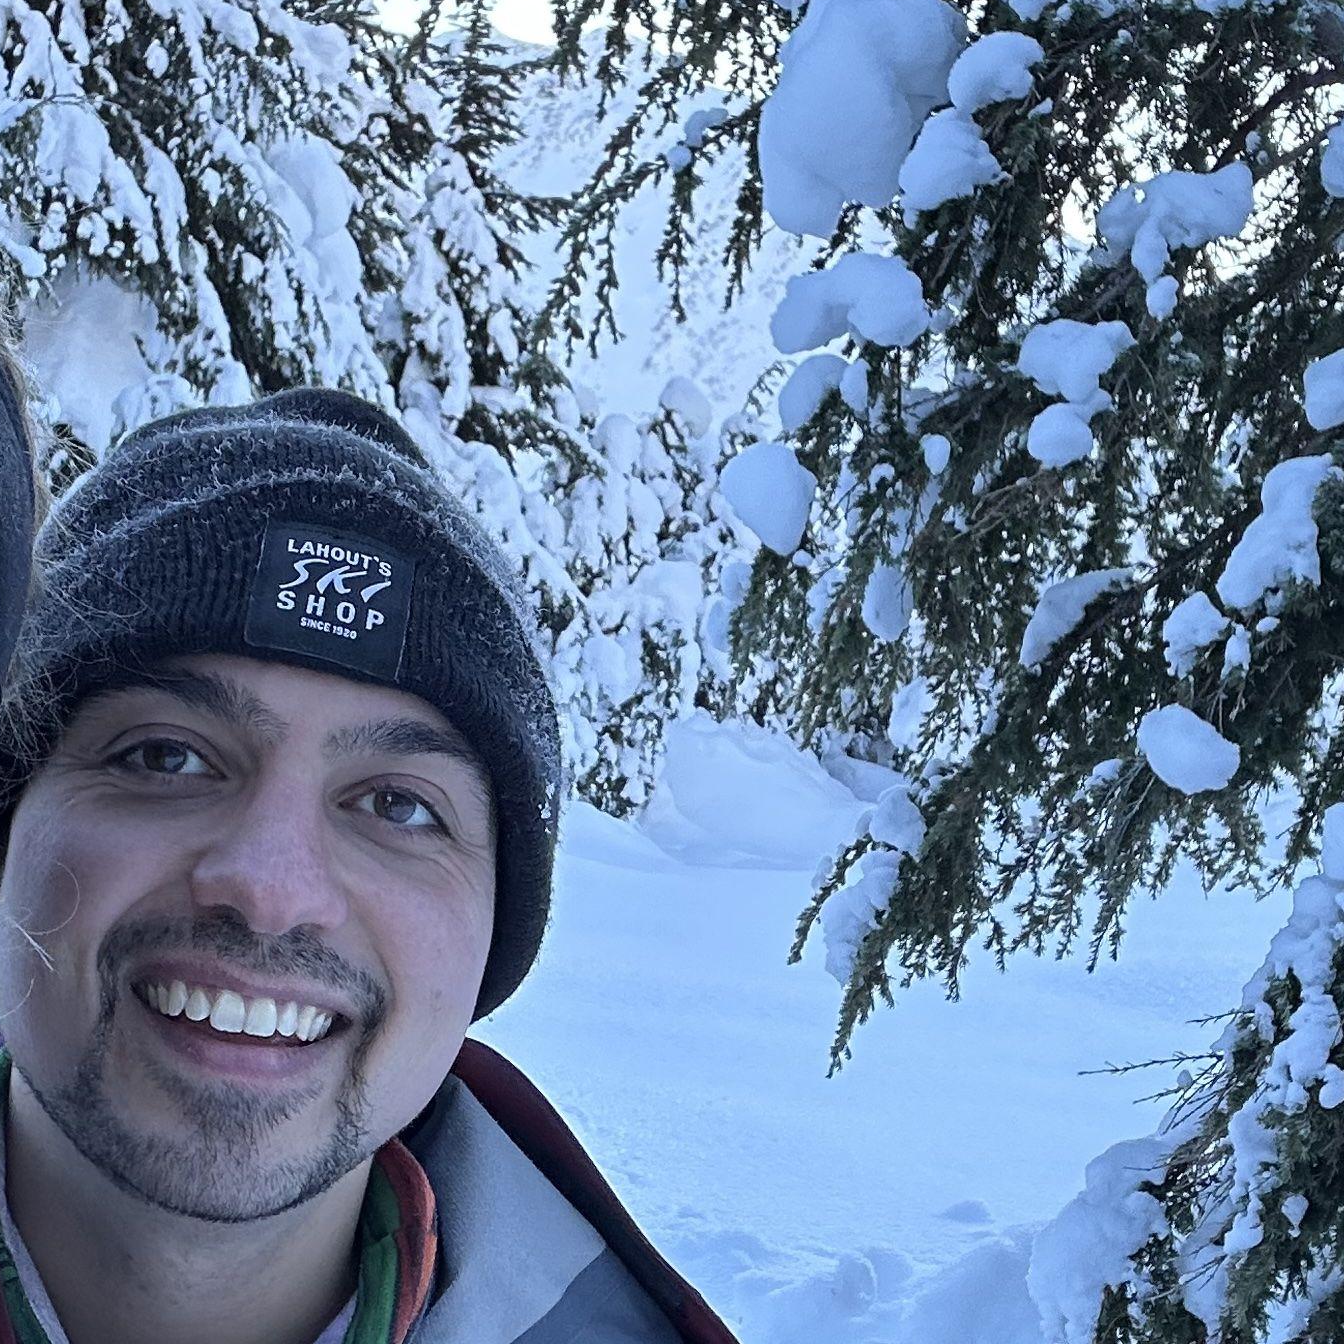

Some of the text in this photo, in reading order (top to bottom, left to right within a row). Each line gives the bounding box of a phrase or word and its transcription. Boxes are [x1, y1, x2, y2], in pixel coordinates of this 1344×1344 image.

[287, 538, 392, 577] LAHOUT'S
[276, 590, 384, 630] SHOP
[300, 616, 357, 640] SINCE 1920
